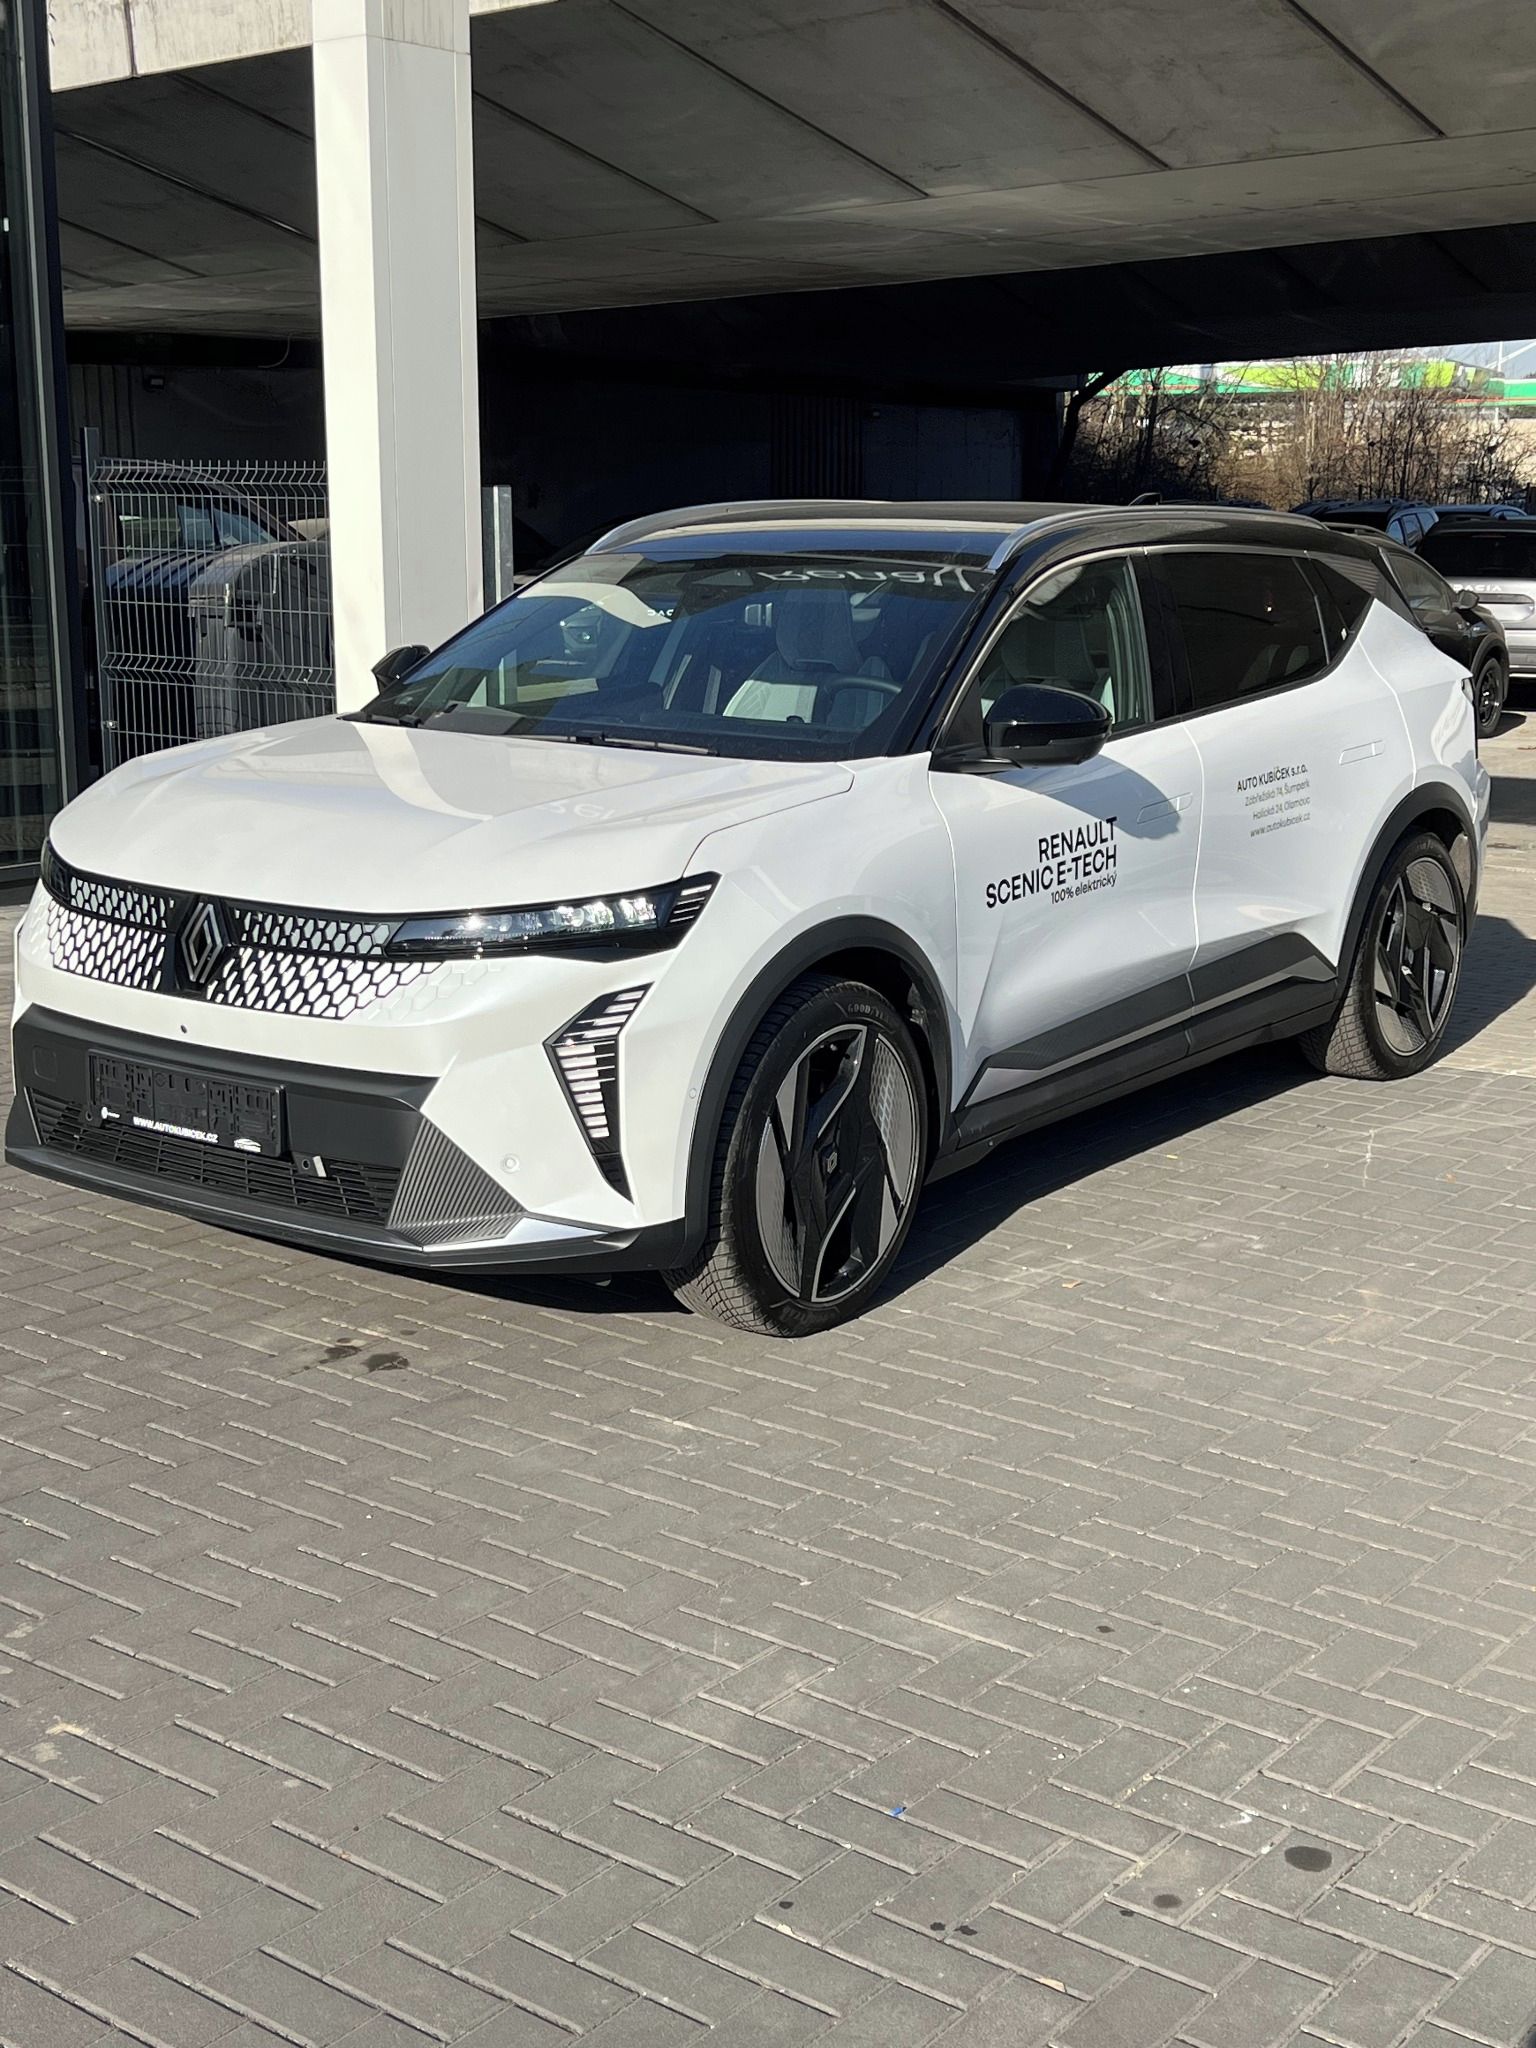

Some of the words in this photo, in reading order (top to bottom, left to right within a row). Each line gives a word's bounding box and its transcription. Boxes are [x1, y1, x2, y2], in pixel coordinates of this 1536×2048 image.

[1453, 583, 1502, 593] DACIA
[1237, 776, 1258, 792] AUTO
[1291, 764, 1308, 777] s.r.o.
[1284, 796, 1310, 810] Olomouc
[1250, 813, 1311, 837] www.autokubicek.cz
[1038, 816, 1118, 863] RENAULT
[986, 866, 1053, 908] SCENIC
[1056, 844, 1117, 886] E-TECH
[1051, 886, 1074, 904] 100%
[1074, 871, 1117, 896] elektrický
[133, 1116, 218, 1143] WWW.AUTOKUBICEK.CZ
